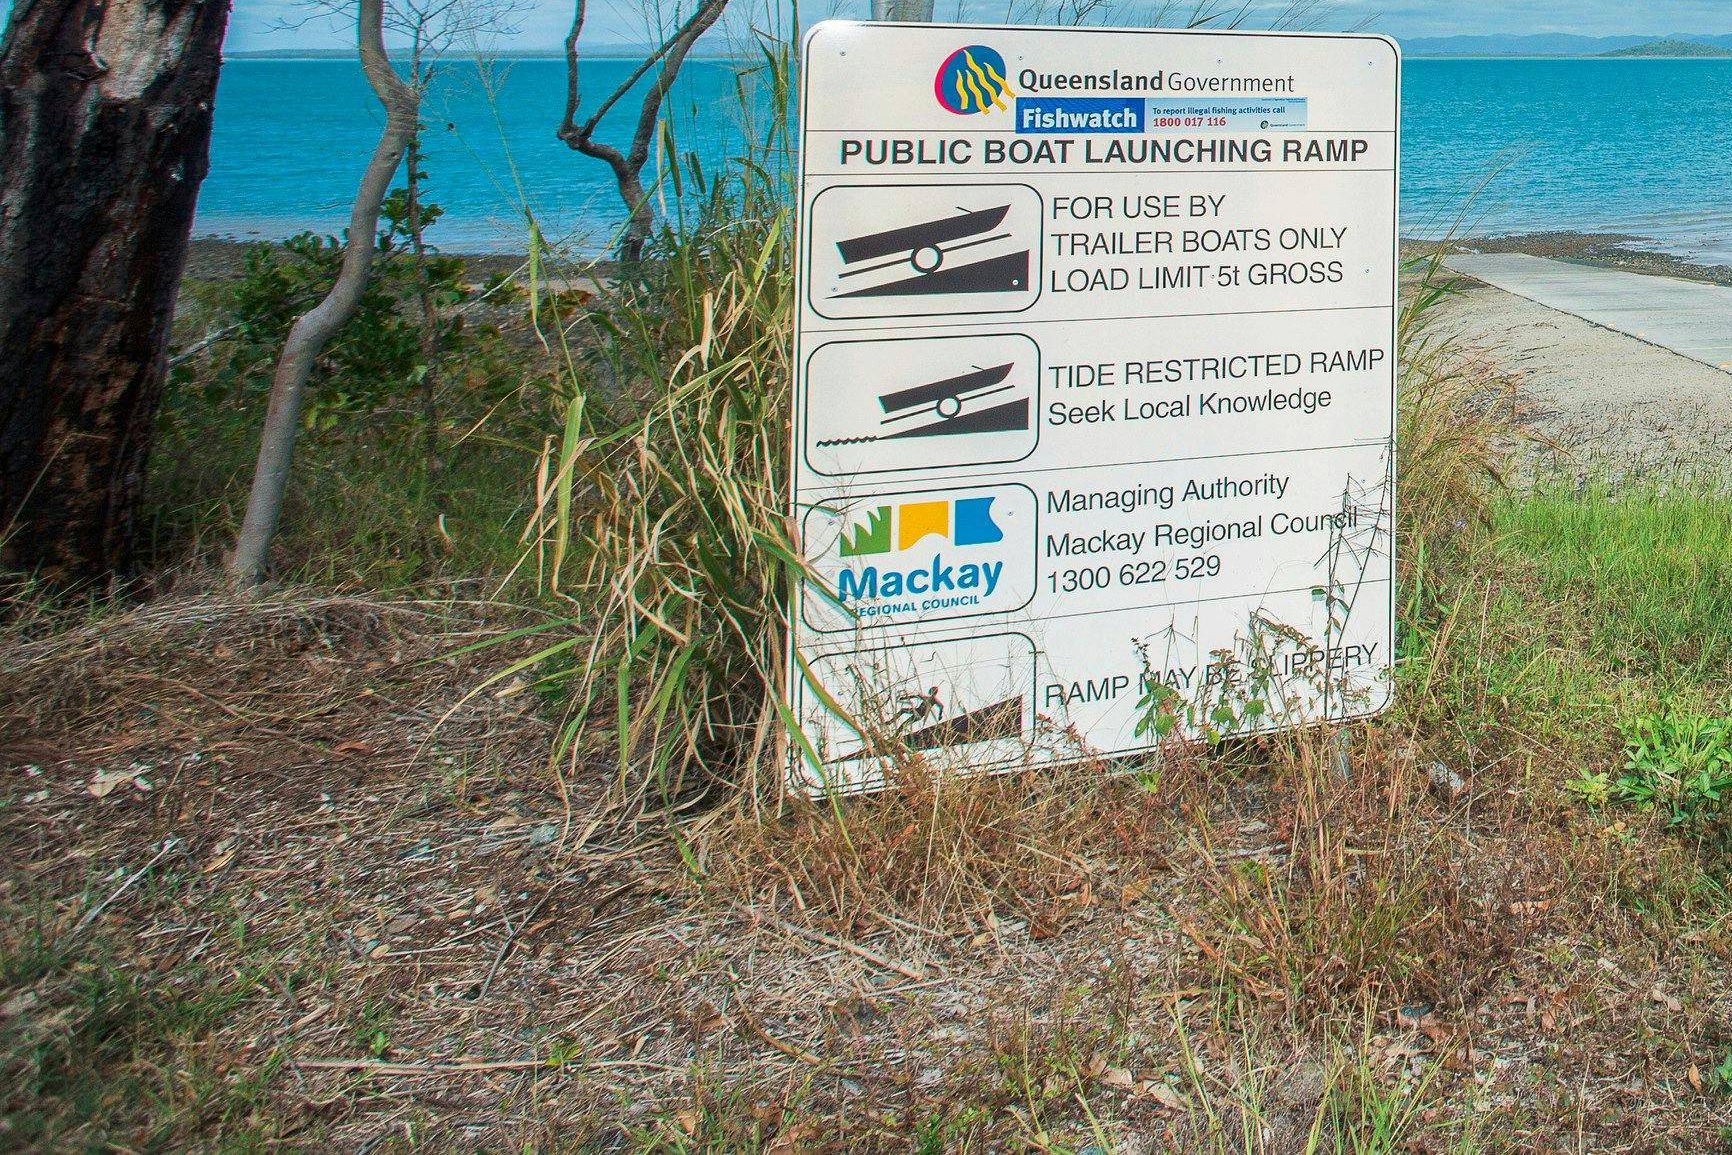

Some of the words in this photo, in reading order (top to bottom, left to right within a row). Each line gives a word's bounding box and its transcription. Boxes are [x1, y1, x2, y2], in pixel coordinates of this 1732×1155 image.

[1018, 68, 1163, 92] Queensland
[1167, 72, 1295, 93] Government
[1022, 107, 1137, 129] Fishwatch
[1153, 117, 1181, 127] 1800
[1184, 117, 1203, 127] 017
[1207, 117, 1226, 127] 116
[1162, 107, 1186, 117] report
[1187, 106, 1211, 116] illegal
[1211, 106, 1237, 116] fishing
[1238, 106, 1271, 114] activities
[1272, 106, 1286, 114] call
[840, 140, 972, 165] PUBLIC
[984, 140, 1075, 165] BOAT
[1085, 139, 1273, 164] LAUNCHING
[1282, 140, 1369, 163] RAMP
[1052, 196, 1114, 220] FOR
[1122, 195, 1181, 218] USE
[1190, 195, 1226, 218] BY
[1050, 230, 1174, 257] TRAILER
[1183, 228, 1272, 254] BOATS
[1280, 227, 1348, 251] ONLY
[1051, 266, 1130, 293] LOAD
[1139, 265, 1209, 289] LIMIT
[1217, 264, 1240, 288] 5t
[1247, 261, 1344, 286] GROSS
[1049, 364, 1115, 390] TIDE
[1125, 353, 1302, 385] RESTRICTED
[1310, 349, 1385, 376] RAMP
[1048, 399, 1115, 426] Seek
[1123, 392, 1191, 420] Local
[1199, 387, 1332, 417] Knowledge
[1047, 484, 1175, 516] Managing
[1183, 472, 1290, 502] Authority
[1046, 529, 1145, 559] Mackay
[1154, 516, 1263, 549] Regional
[1271, 505, 1357, 535] Council
[838, 552, 1003, 603] Mackay
[1047, 567, 1112, 594] 1300
[1120, 561, 1166, 588] 622
[1174, 555, 1221, 581] 529
[853, 602, 917, 617] EGIONAL
[921, 595, 980, 611] COUNCIL
[1044, 675, 1130, 709] RAMP
